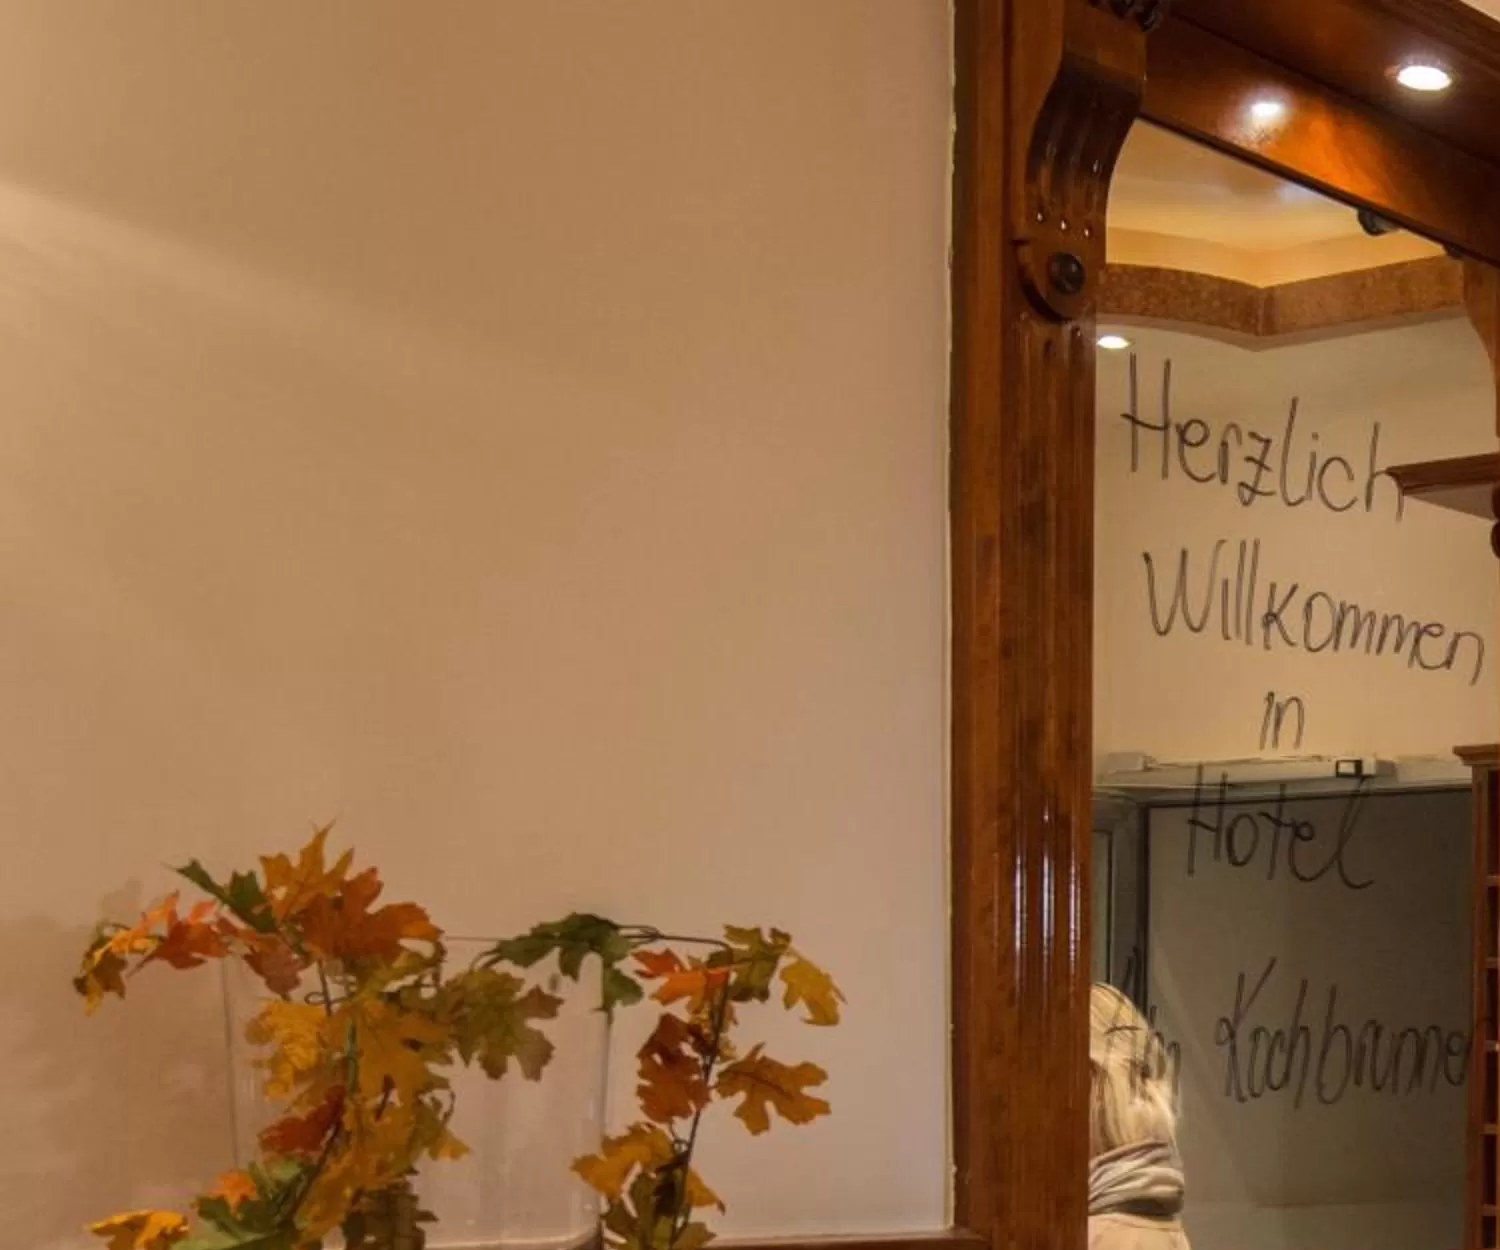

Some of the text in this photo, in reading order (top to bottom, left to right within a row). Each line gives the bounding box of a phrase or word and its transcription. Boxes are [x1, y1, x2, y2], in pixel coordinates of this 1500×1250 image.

[1120, 352, 1403, 521] Herzlich
[1142, 538, 1485, 686] Willkommen
[1187, 763, 1374, 889] Hotel
[1215, 956, 1478, 1109] Kochbrunne
